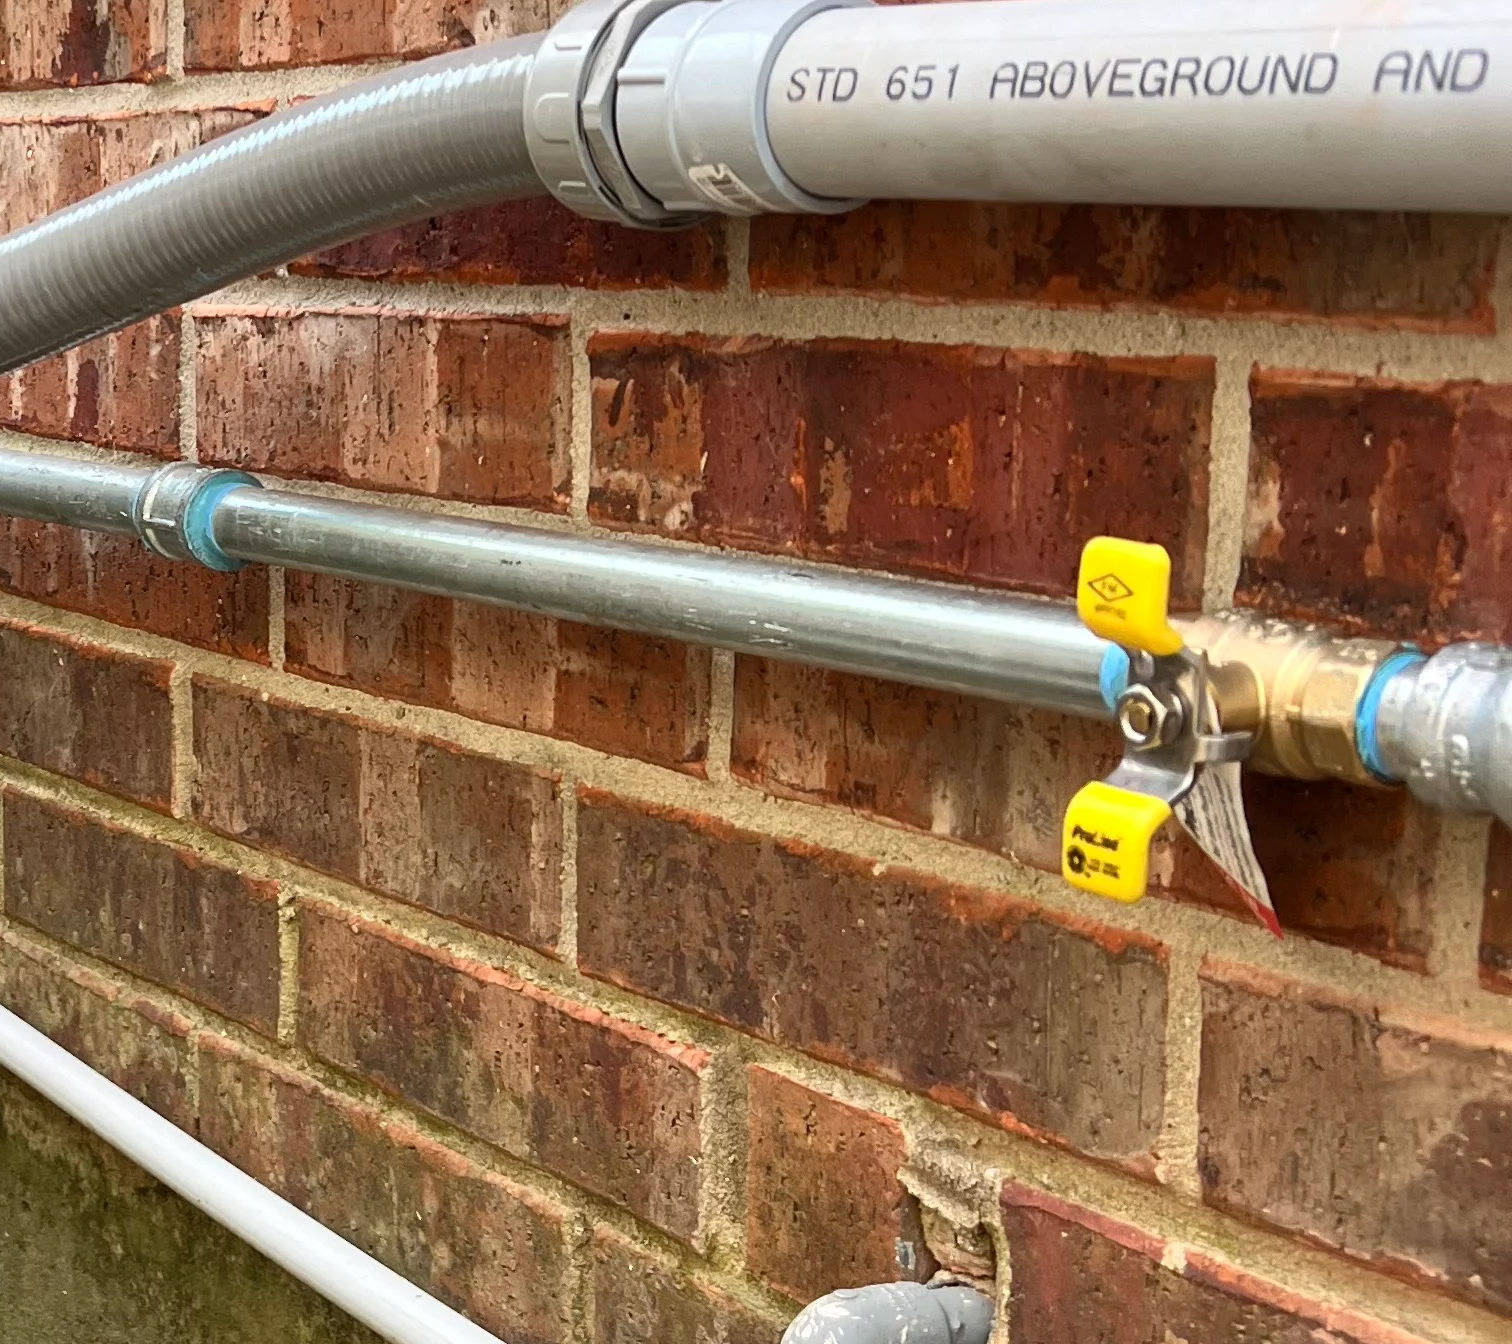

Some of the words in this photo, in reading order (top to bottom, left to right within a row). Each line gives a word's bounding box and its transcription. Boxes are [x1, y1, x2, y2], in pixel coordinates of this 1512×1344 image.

[785, 67, 859, 104] STD
[885, 63, 959, 102] 651
[989, 52, 1339, 101] ABOVEGROUND
[1373, 47, 1491, 96] AND
